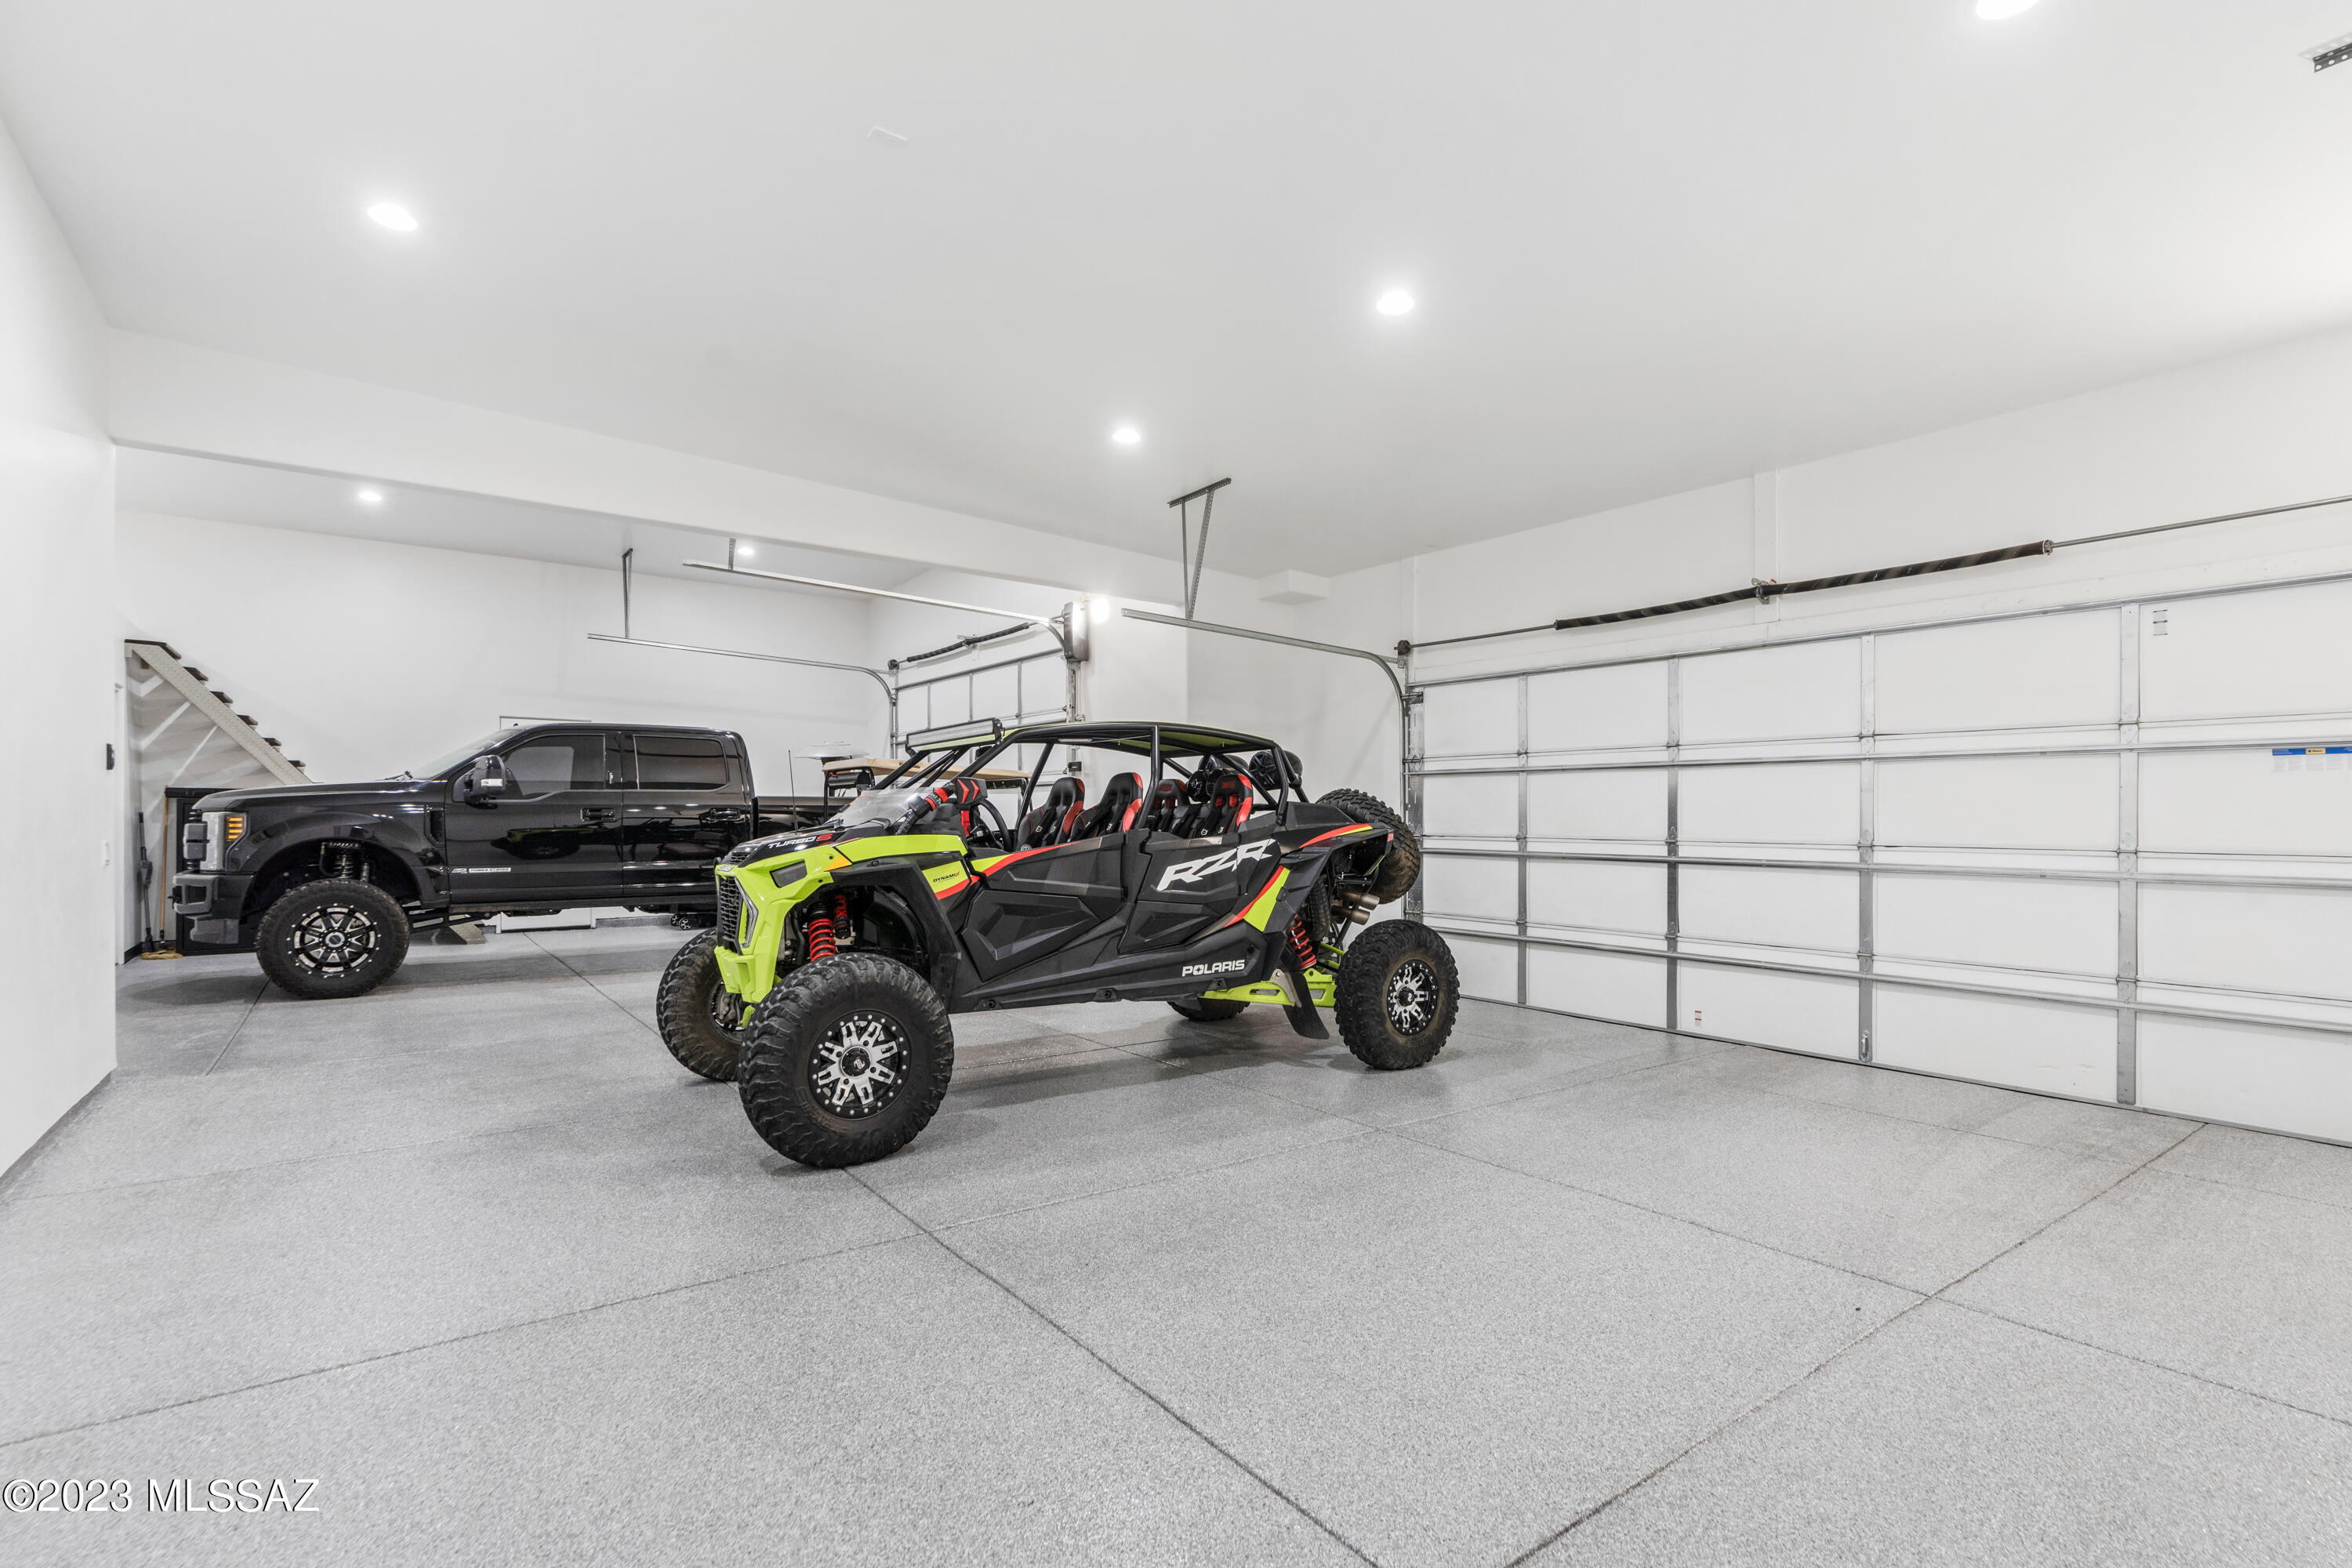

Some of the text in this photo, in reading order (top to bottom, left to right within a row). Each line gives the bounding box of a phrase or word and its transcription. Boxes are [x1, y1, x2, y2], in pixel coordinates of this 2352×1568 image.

[1156, 838, 1276, 891] RZR
[933, 871, 960, 883] DYNAMIX
[1181, 959, 1246, 978] POLARIS
